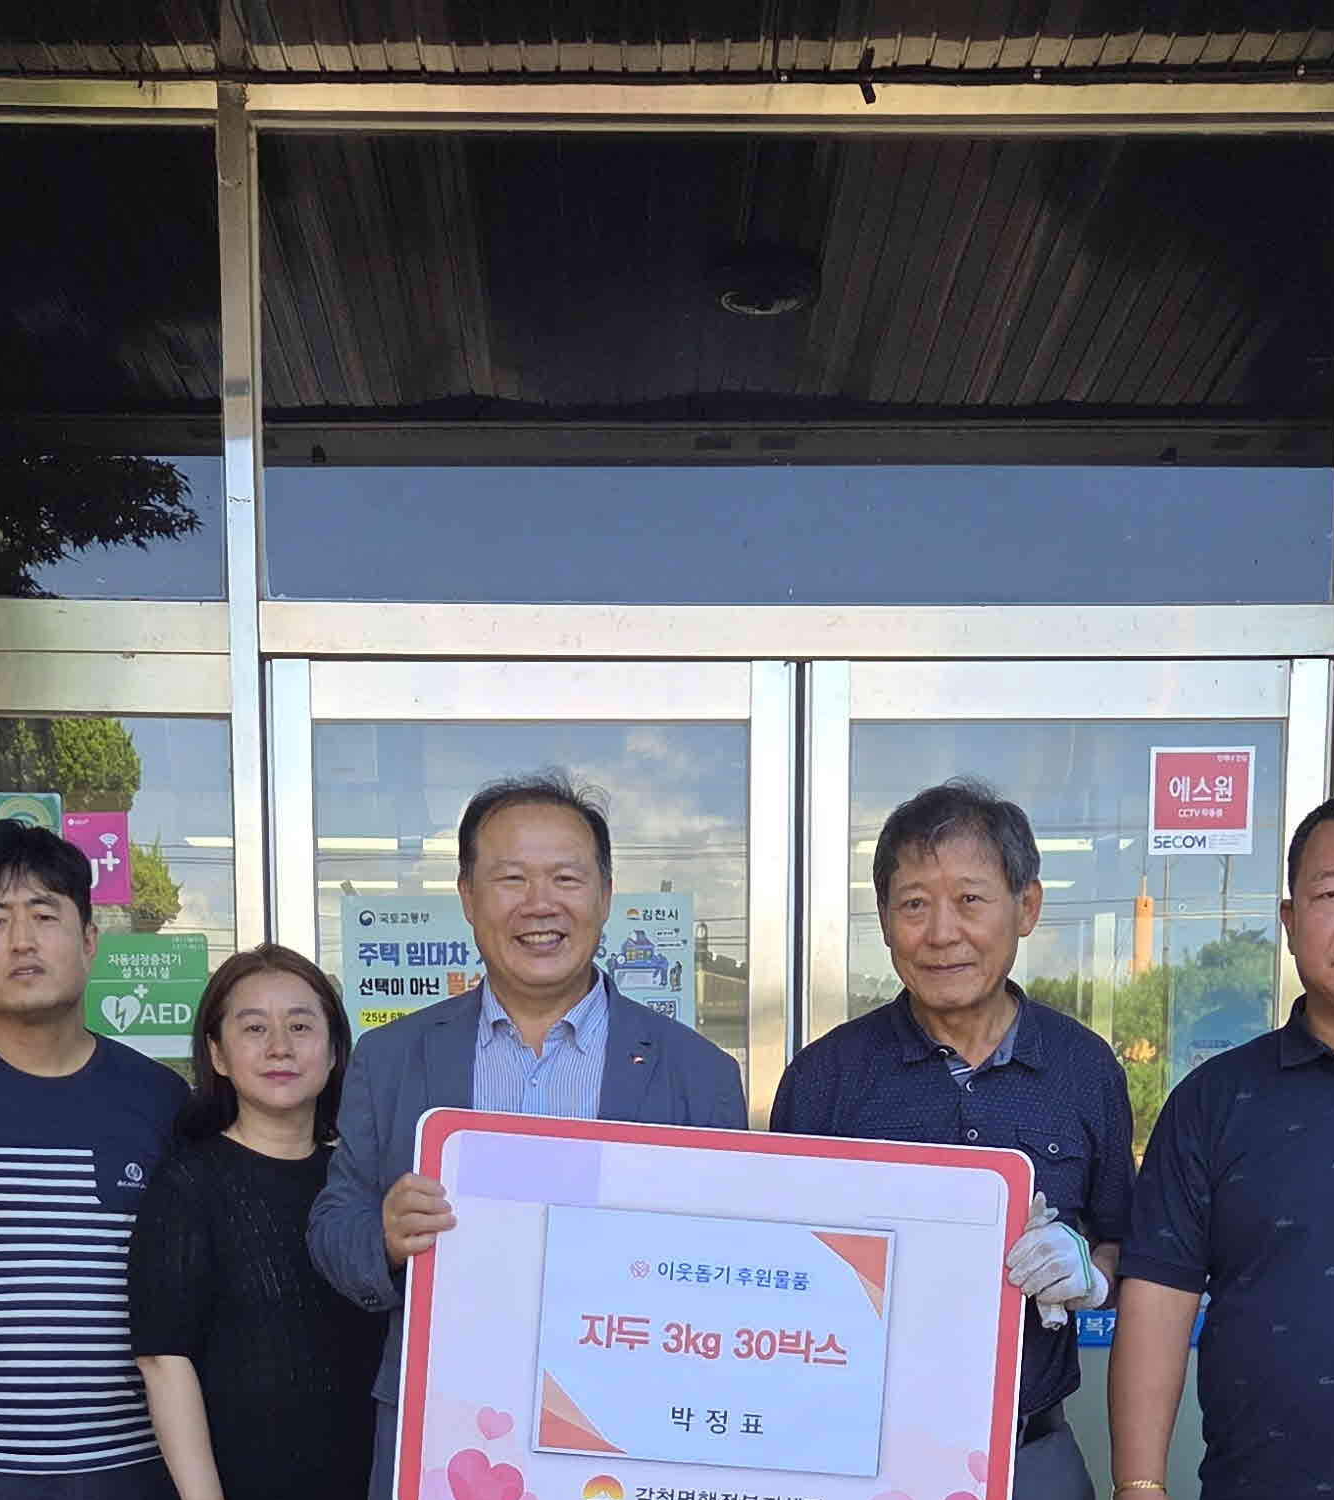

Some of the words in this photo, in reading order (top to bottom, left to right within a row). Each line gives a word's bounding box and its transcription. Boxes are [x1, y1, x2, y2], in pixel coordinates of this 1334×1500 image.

[1169, 776, 1233, 803] 에스원
[1153, 835, 1207, 849] SECOM
[642, 908, 678, 920] 김천시
[359, 942, 399, 967] 주택
[406, 941, 470, 966] 임대차
[359, 977, 404, 995] 선택이
[410, 977, 440, 995] 아닌
[139, 1003, 192, 1024] AED
[658, 1261, 730, 1285] 이웃돕기
[735, 1267, 810, 1291] 후원물품
[578, 1314, 651, 1350] 자두
[662, 1322, 722, 1360] 3kg
[733, 1328, 848, 1365] 30박스
